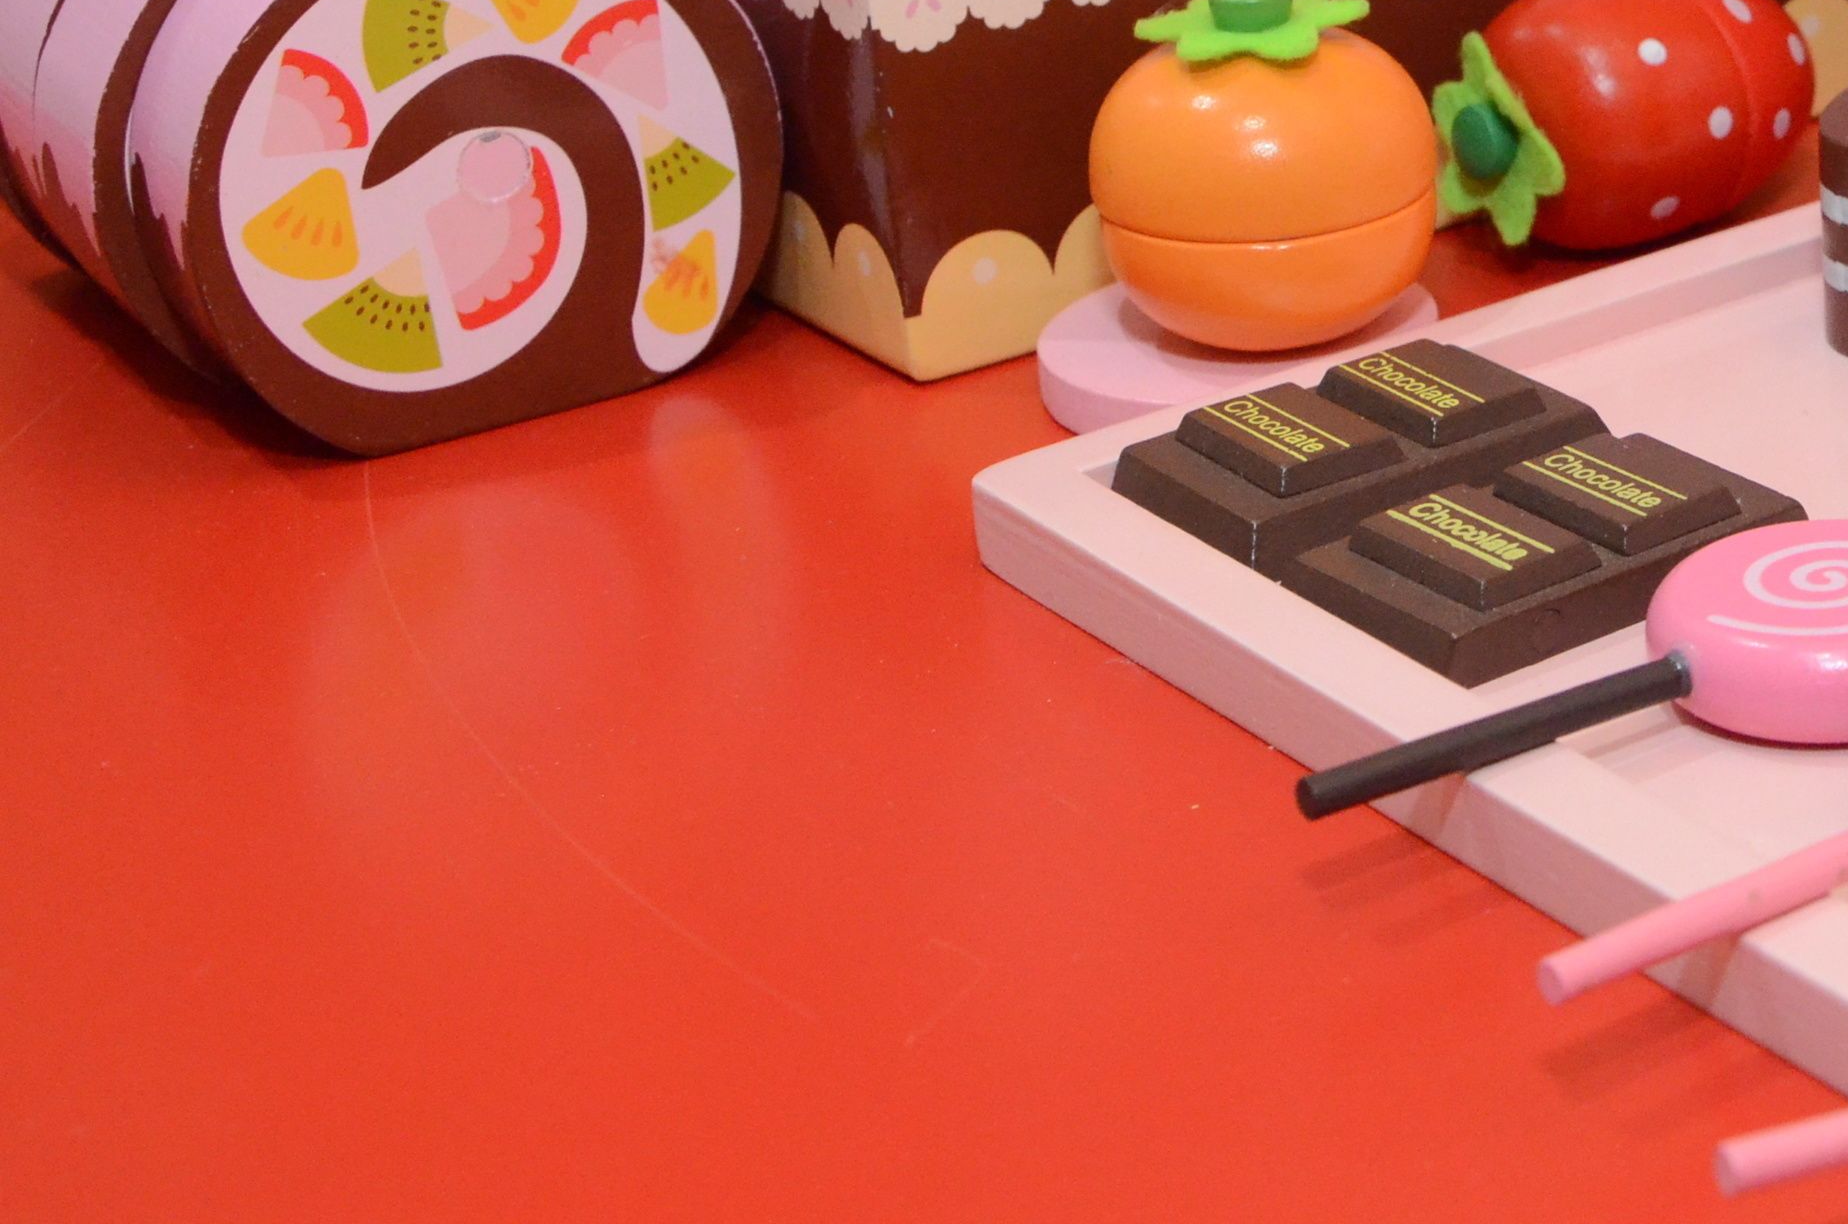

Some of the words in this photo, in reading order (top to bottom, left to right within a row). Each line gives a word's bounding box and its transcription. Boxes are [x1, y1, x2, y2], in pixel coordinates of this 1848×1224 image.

[1358, 355, 1461, 412] Chocolate
[1223, 399, 1326, 456] Chocolate
[1543, 451, 1663, 512] Chocolate
[1408, 501, 1527, 562] Chocolate
